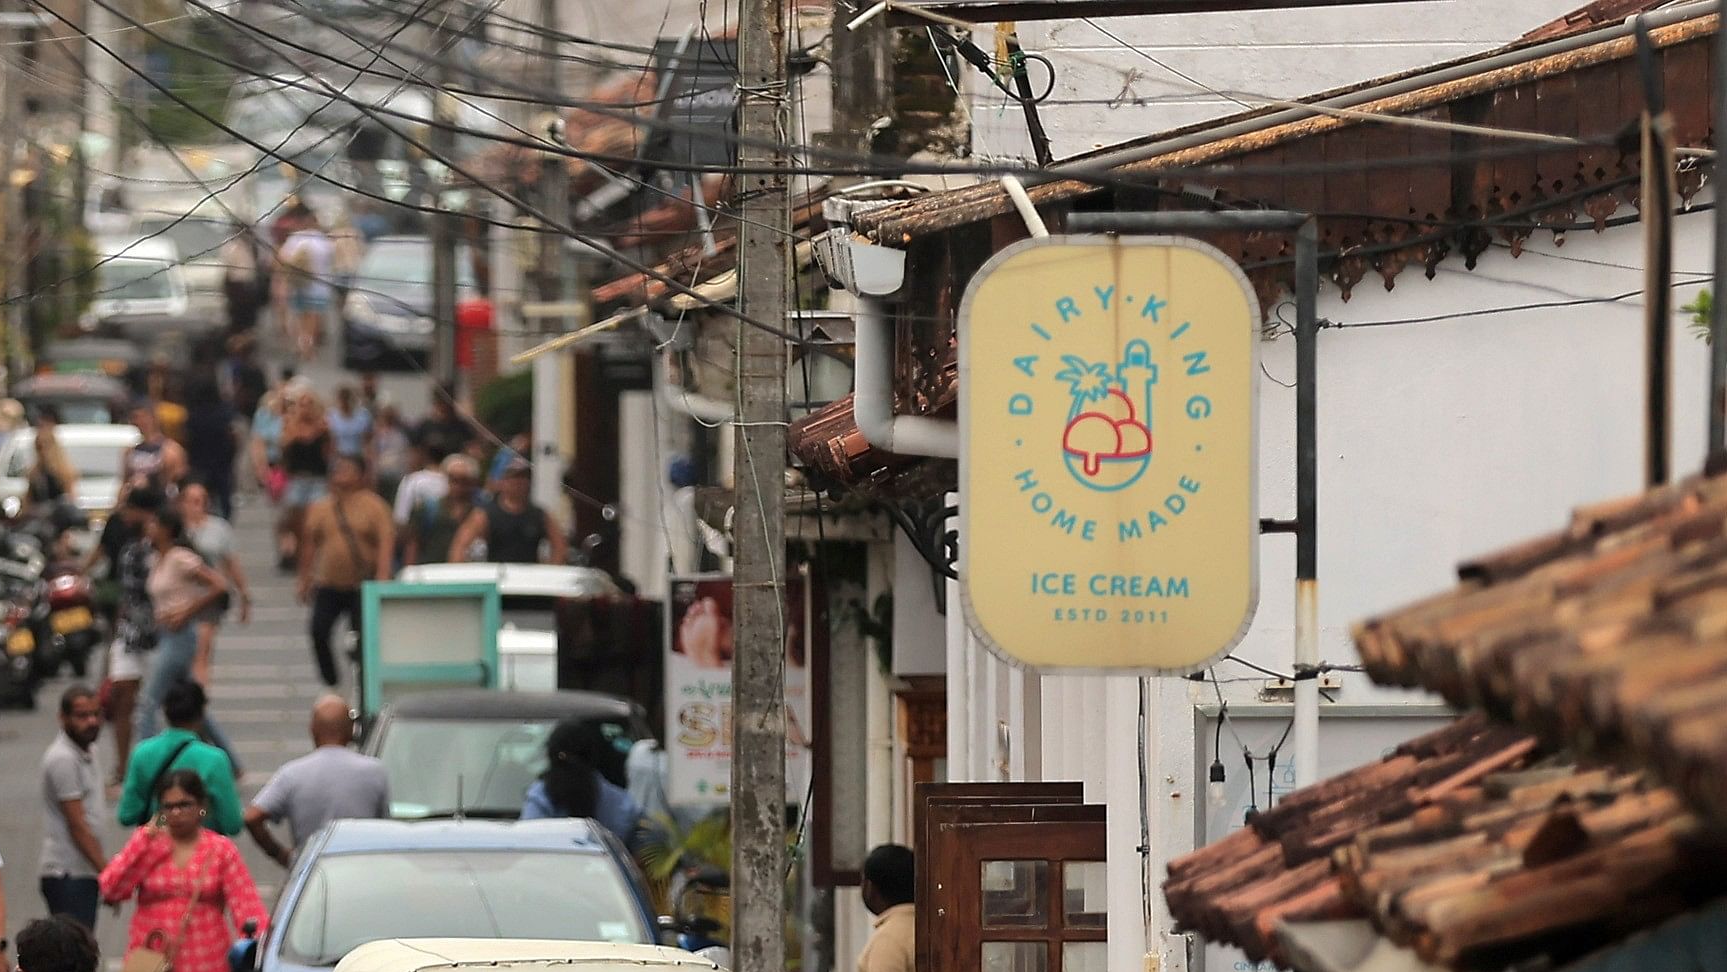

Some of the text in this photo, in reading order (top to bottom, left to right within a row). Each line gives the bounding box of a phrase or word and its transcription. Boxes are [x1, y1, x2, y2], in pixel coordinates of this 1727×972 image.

[1008, 284, 1212, 420] DAIRY KING
[1013, 468, 1201, 542] HOME MADE
[1030, 572, 1190, 599] ICE CREAM
[1053, 608, 1169, 624] ESTD 2011
